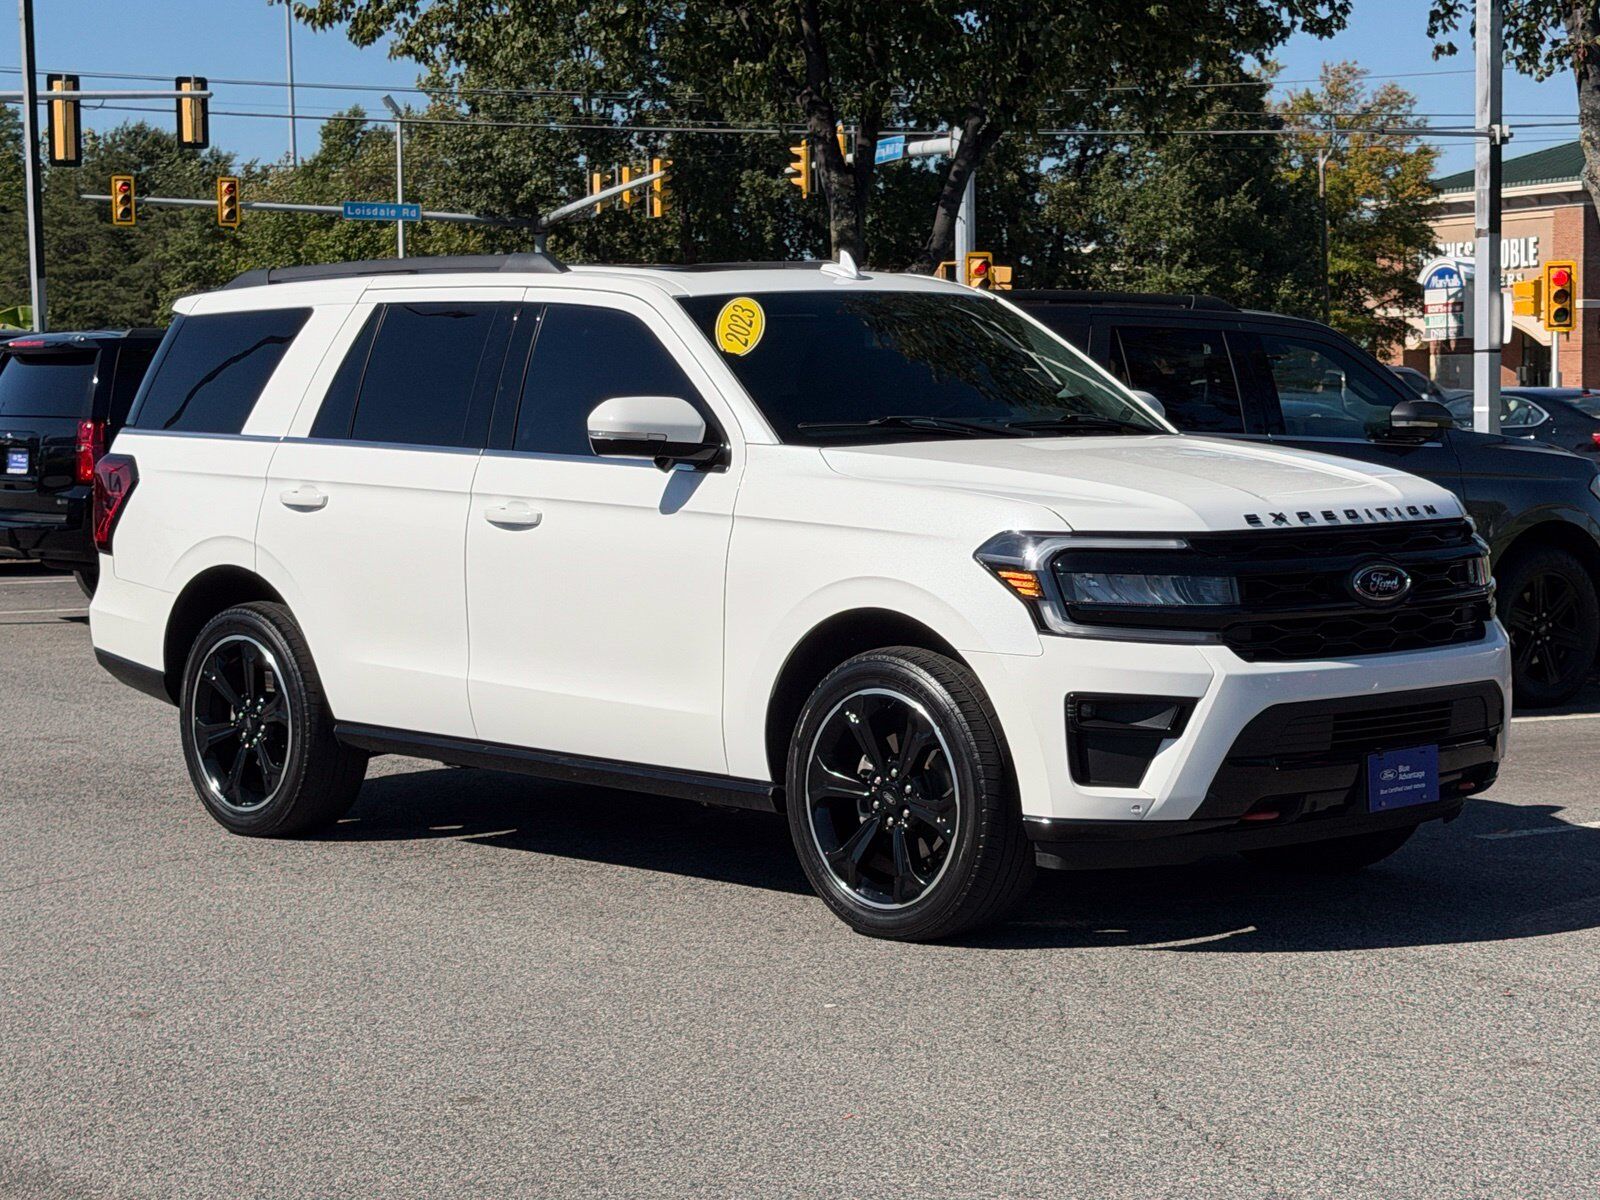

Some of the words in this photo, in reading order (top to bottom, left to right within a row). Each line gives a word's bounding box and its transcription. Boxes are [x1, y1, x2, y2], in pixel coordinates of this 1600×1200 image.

[347, 206, 396, 216] Loisdale
[402, 208, 417, 217] Rd
[1500, 237, 1538, 268] OBLE
[725, 304, 756, 348] 2023
[1243, 504, 1438, 524] EXPEDITION
[1370, 571, 1400, 591] Ford
